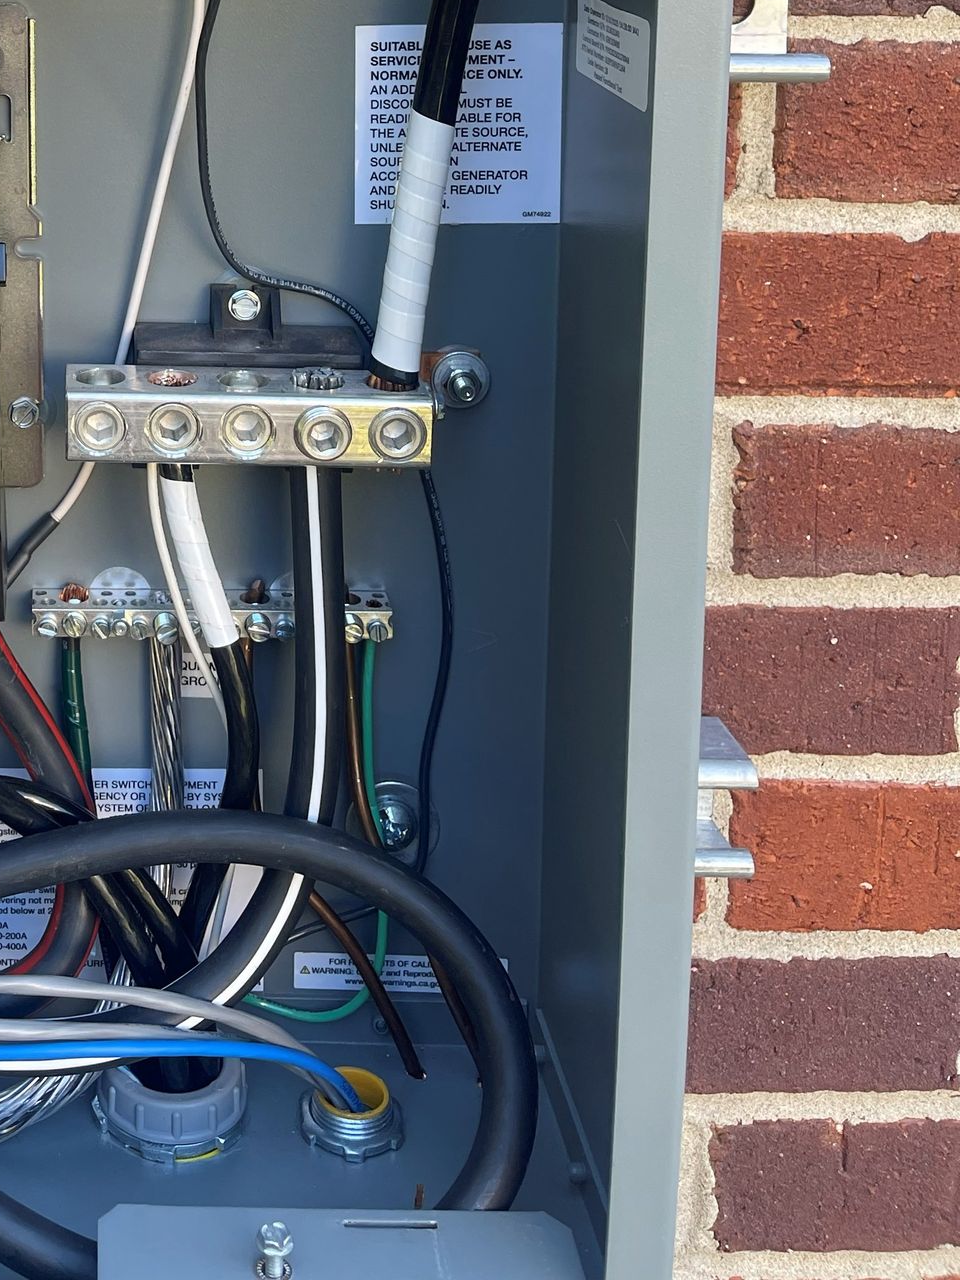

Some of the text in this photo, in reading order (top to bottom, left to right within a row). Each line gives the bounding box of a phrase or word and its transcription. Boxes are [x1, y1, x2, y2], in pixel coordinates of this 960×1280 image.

[370, 41, 422, 52] SUITABL
[494, 39, 512, 50] AS
[370, 70, 417, 81] NORMA
[488, 68, 523, 79] ONLY.
[370, 84, 388, 95] AN
[458, 98, 492, 108] MUST
[496, 98, 513, 108] BE
[370, 114, 409, 124] READI
[495, 112, 521, 123] FOR
[370, 128, 394, 138] THE
[472, 127, 528, 139] SOURCE,
[370, 141, 522, 153] UNLE ALTERNATE
[452, 170, 528, 180] GENERATOR
[370, 184, 502, 196] AND READILY
[370, 200, 395, 210] SHU
[112, 780, 152, 789] SWITCH
[130, 793, 146, 801] OR
[98, 804, 133, 813] YSTEM
[10, 907, 35, 915] below
